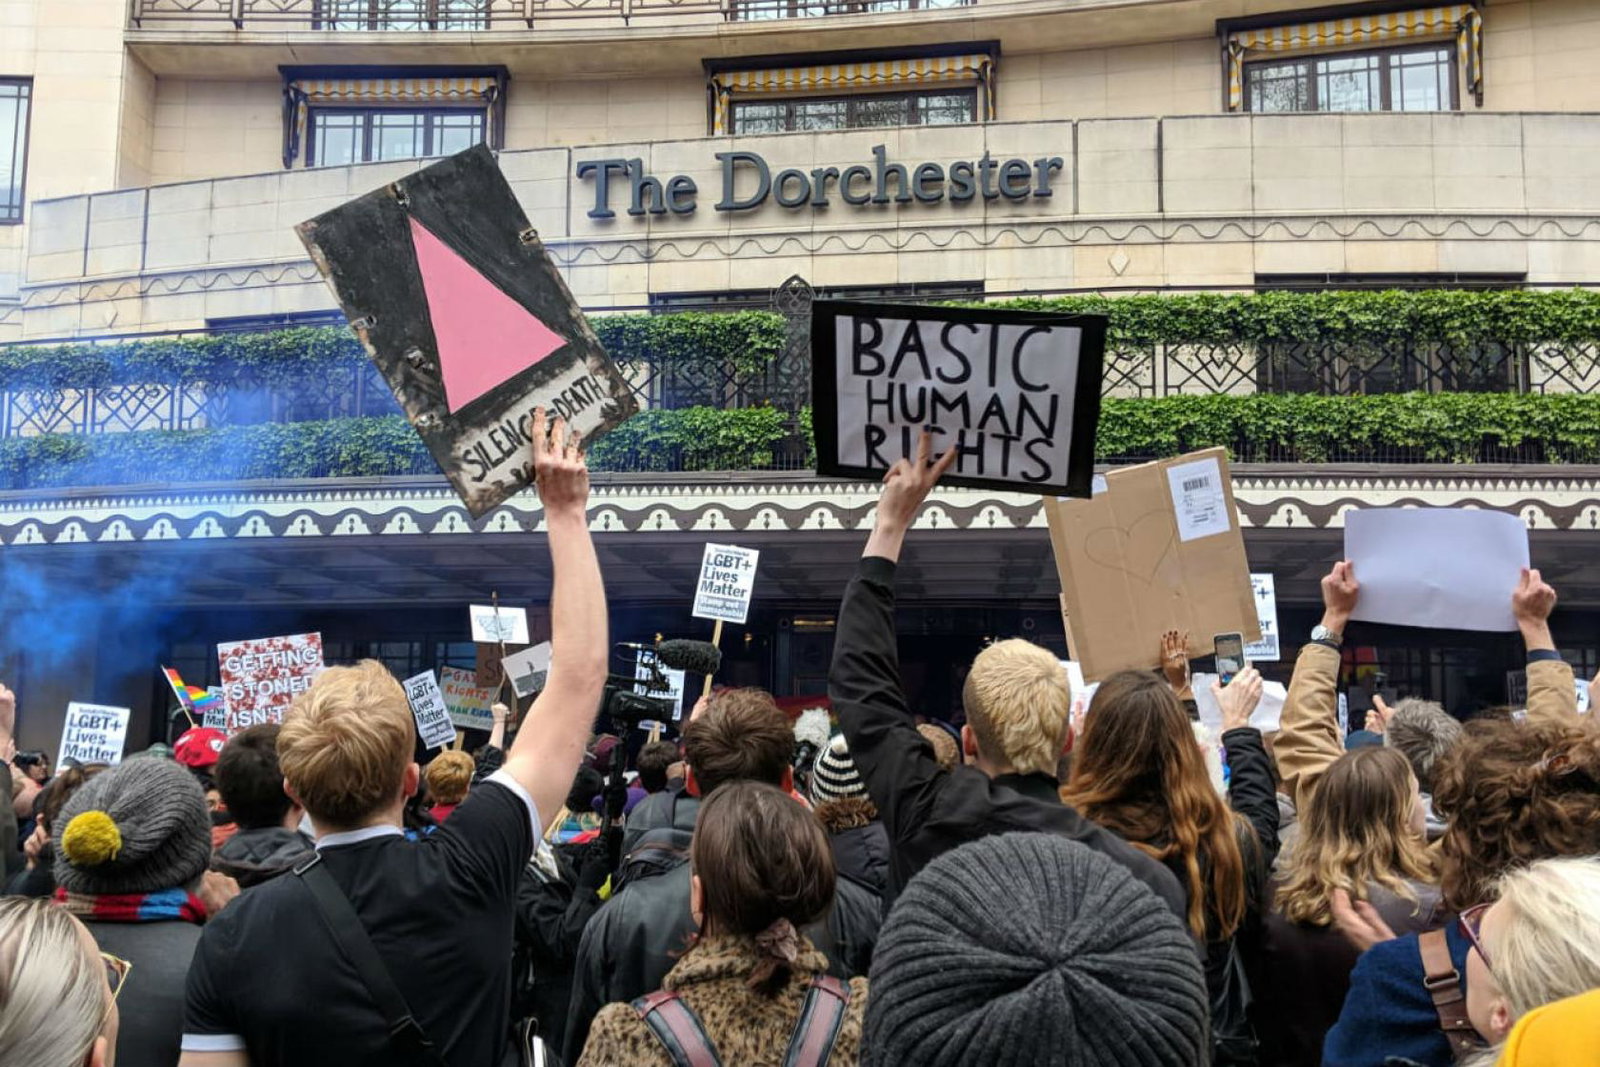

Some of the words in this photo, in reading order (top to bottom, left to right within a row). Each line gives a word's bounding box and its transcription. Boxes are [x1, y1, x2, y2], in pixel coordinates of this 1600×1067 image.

[576, 158, 698, 218] The
[715, 145, 1064, 211] Dorchester
[853, 316, 1052, 392] BASIC
[867, 379, 1059, 439] HUMAN
[706, 553, 752, 571] LGBT+
[703, 566, 738, 583] Lives
[700, 580, 748, 598] Matter
[225, 648, 318, 673] GETTING
[408, 681, 435, 701] LGBT+
[69, 712, 122, 732] LGBT+
[205, 715, 225, 727] Mat
[232, 706, 284, 728] ISN'T
[417, 707, 445, 725] Matter
[66, 728, 107, 745] Lives
[63, 743, 117, 761] Matter
